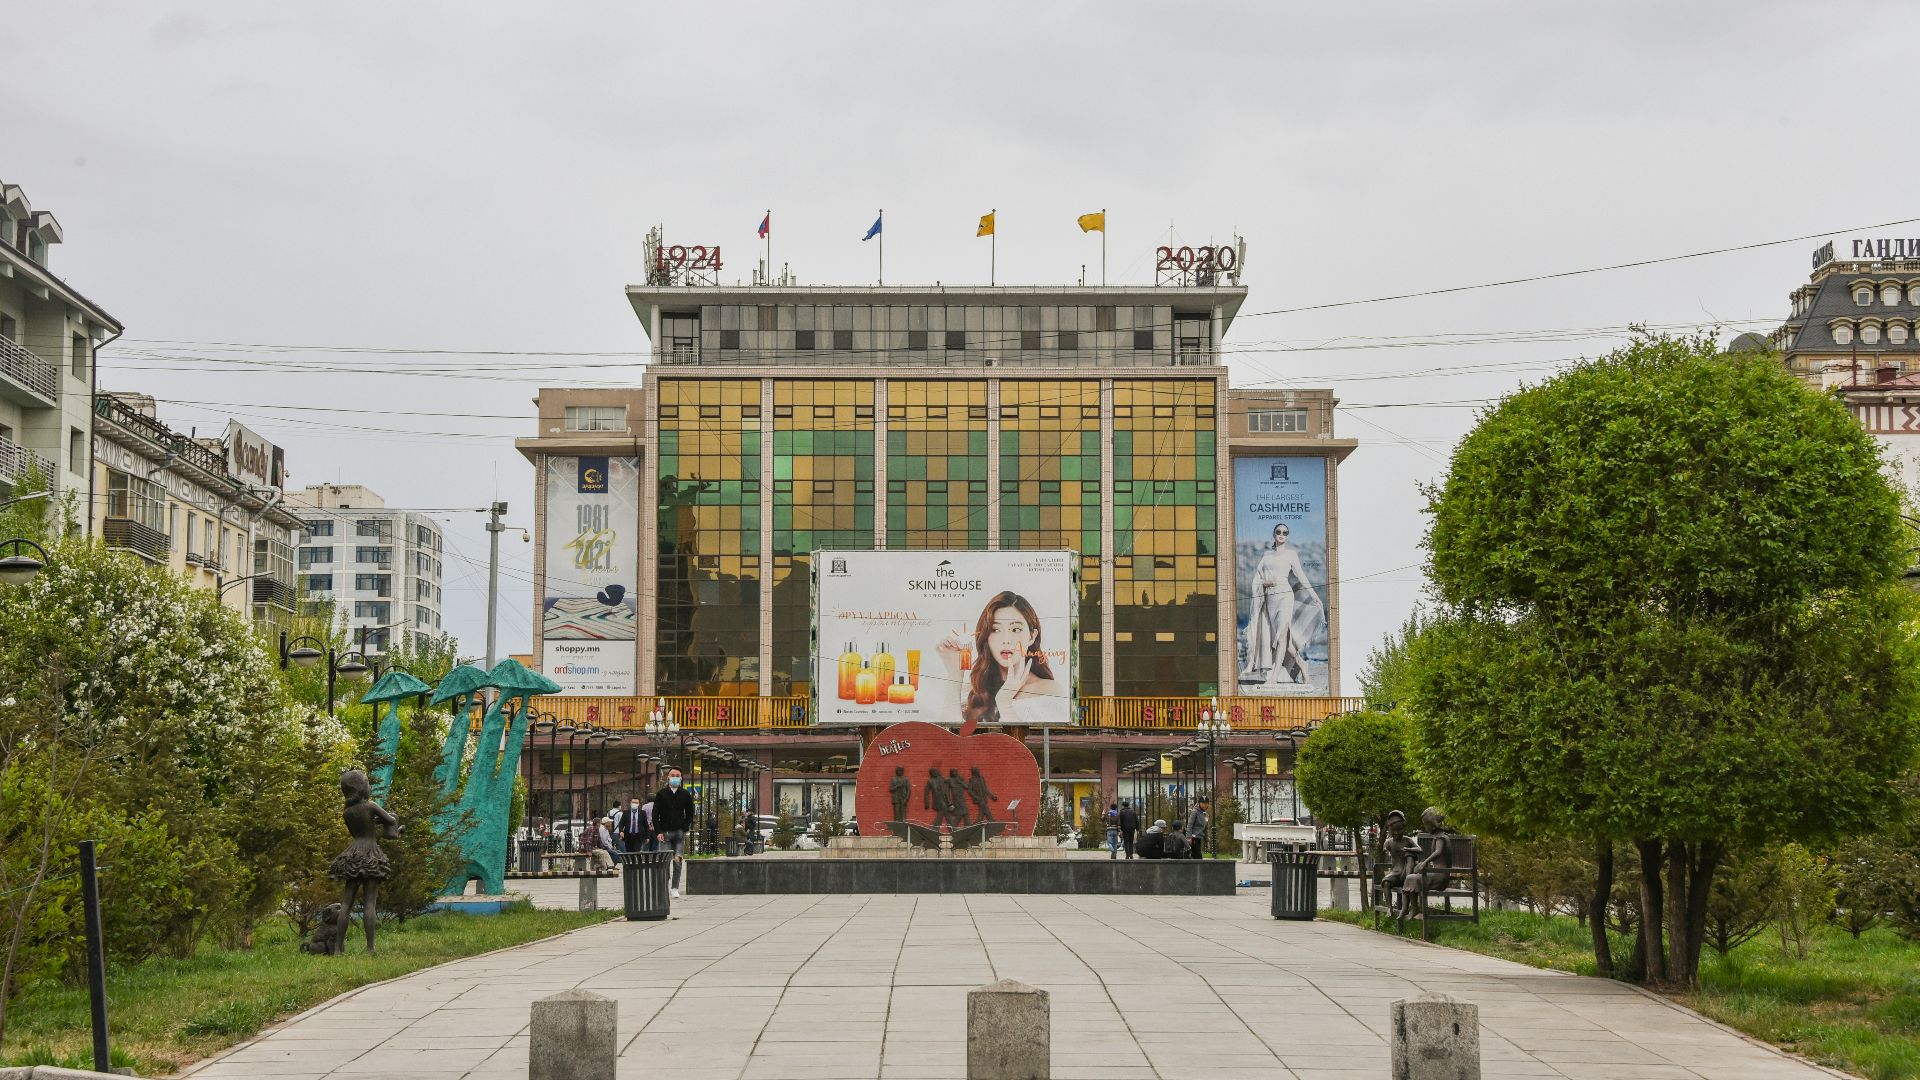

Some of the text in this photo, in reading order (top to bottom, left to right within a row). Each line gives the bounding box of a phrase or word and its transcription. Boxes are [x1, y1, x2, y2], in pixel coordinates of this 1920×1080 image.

[656, 245, 724, 271] 1924
[1156, 245, 1236, 271] 2020
[1249, 502, 1311, 513] CASHMERE
[576, 504, 609, 534] 1981
[936, 567, 955, 577] the
[908, 580, 982, 591] SKIN HOUSE
[555, 645, 600, 653] shoppy.mn
[1012, 640, 1067, 665] Amazing
